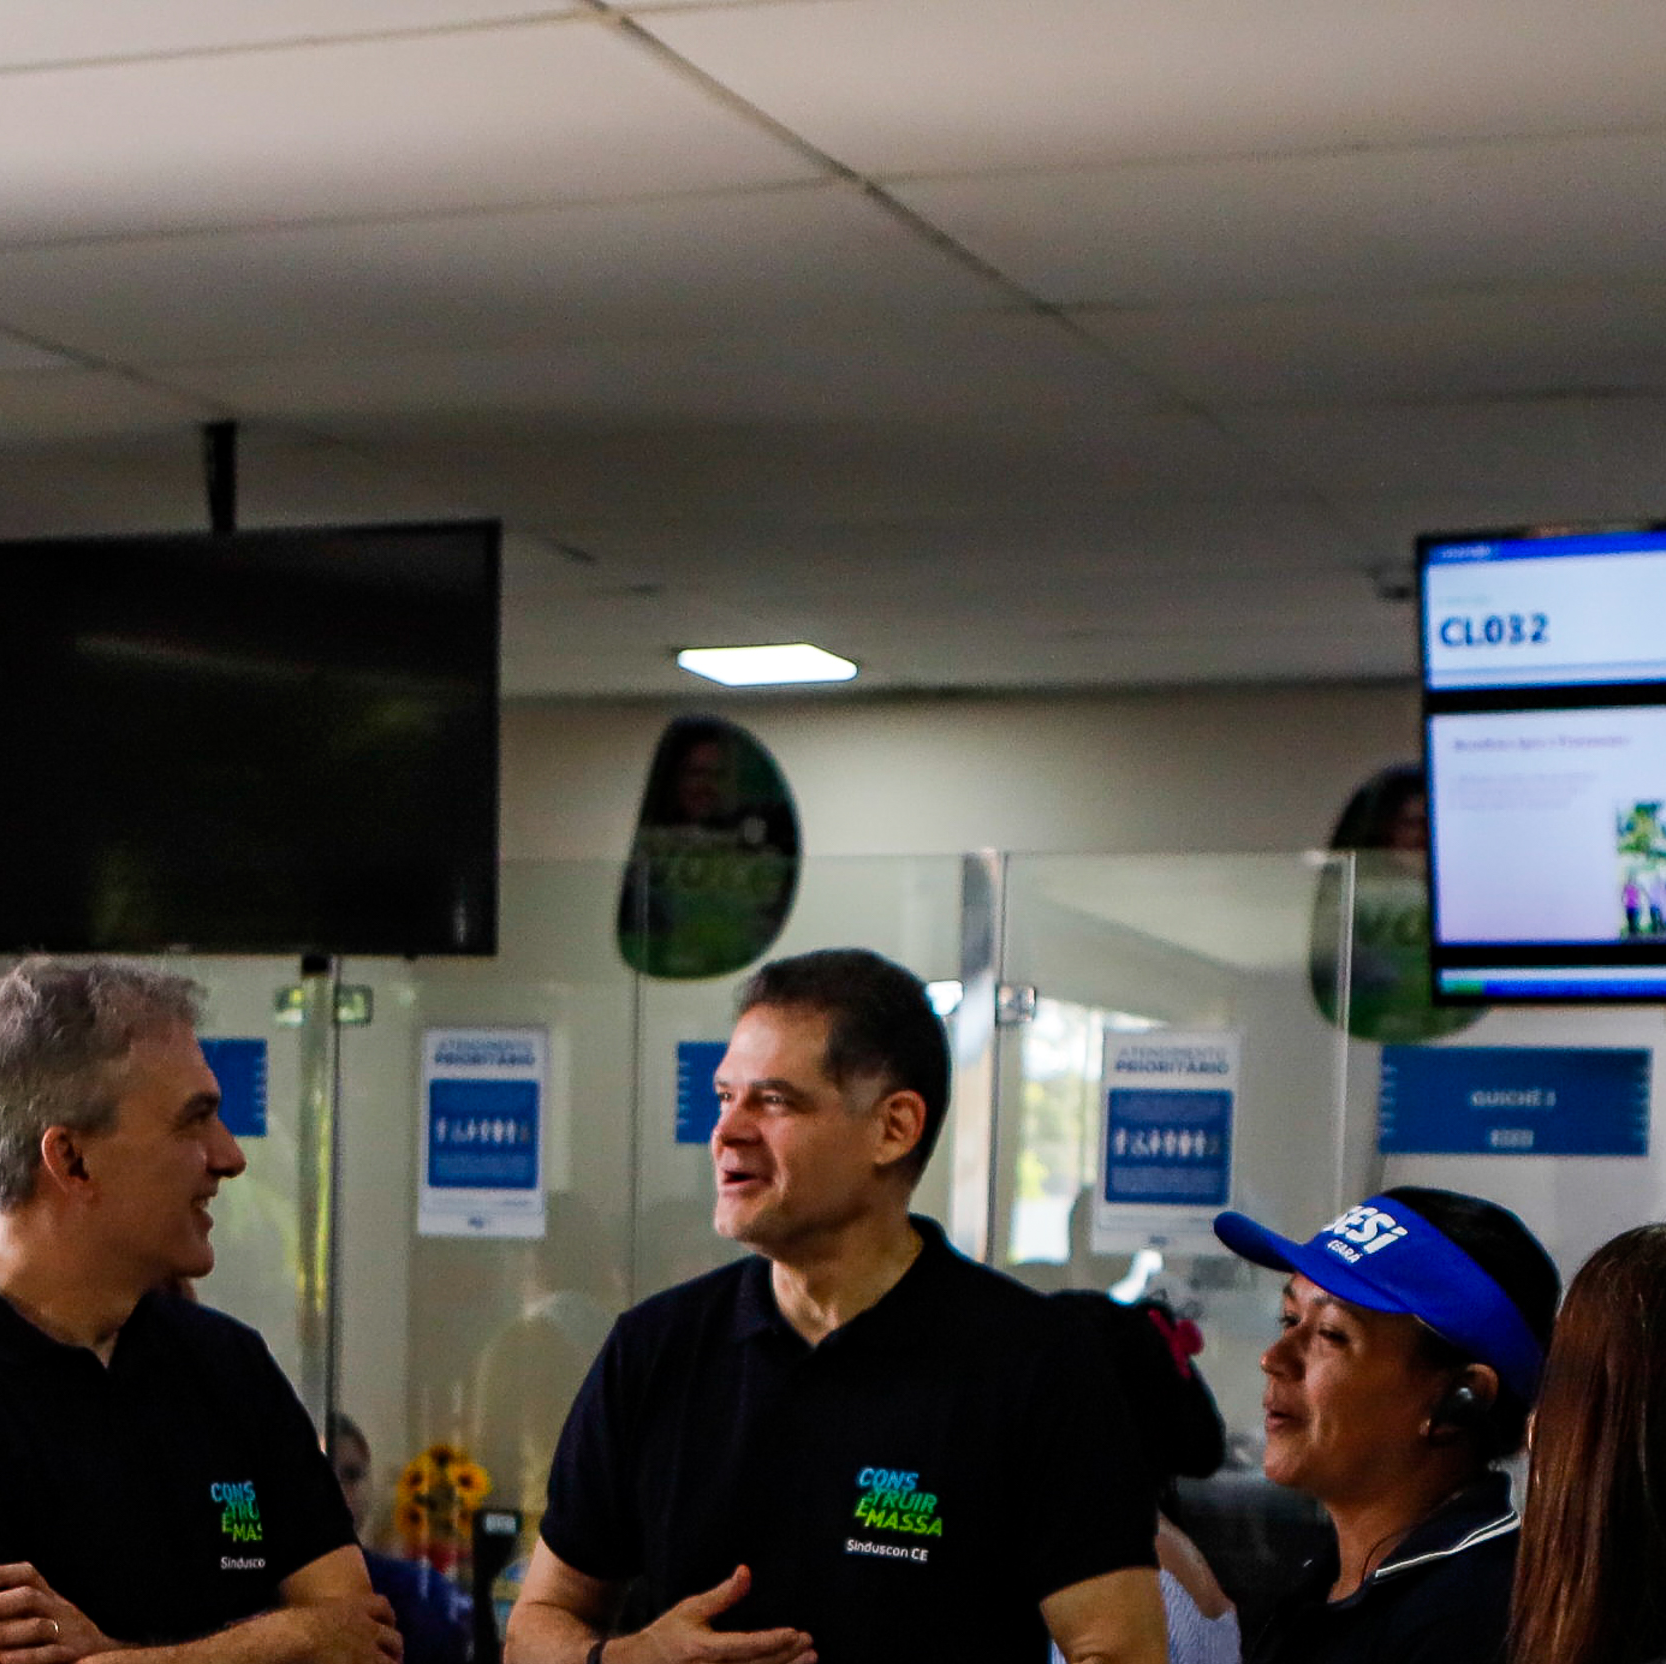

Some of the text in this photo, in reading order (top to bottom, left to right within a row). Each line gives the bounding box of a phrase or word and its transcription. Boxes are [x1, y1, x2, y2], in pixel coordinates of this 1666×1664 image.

[858, 1467, 919, 1491] CONS
[210, 1481, 257, 1503] CONS
[873, 1487, 938, 1514] TRUIR
[864, 1508, 943, 1537] MASSA
[846, 1539, 929, 1562] Sinduscon CE
